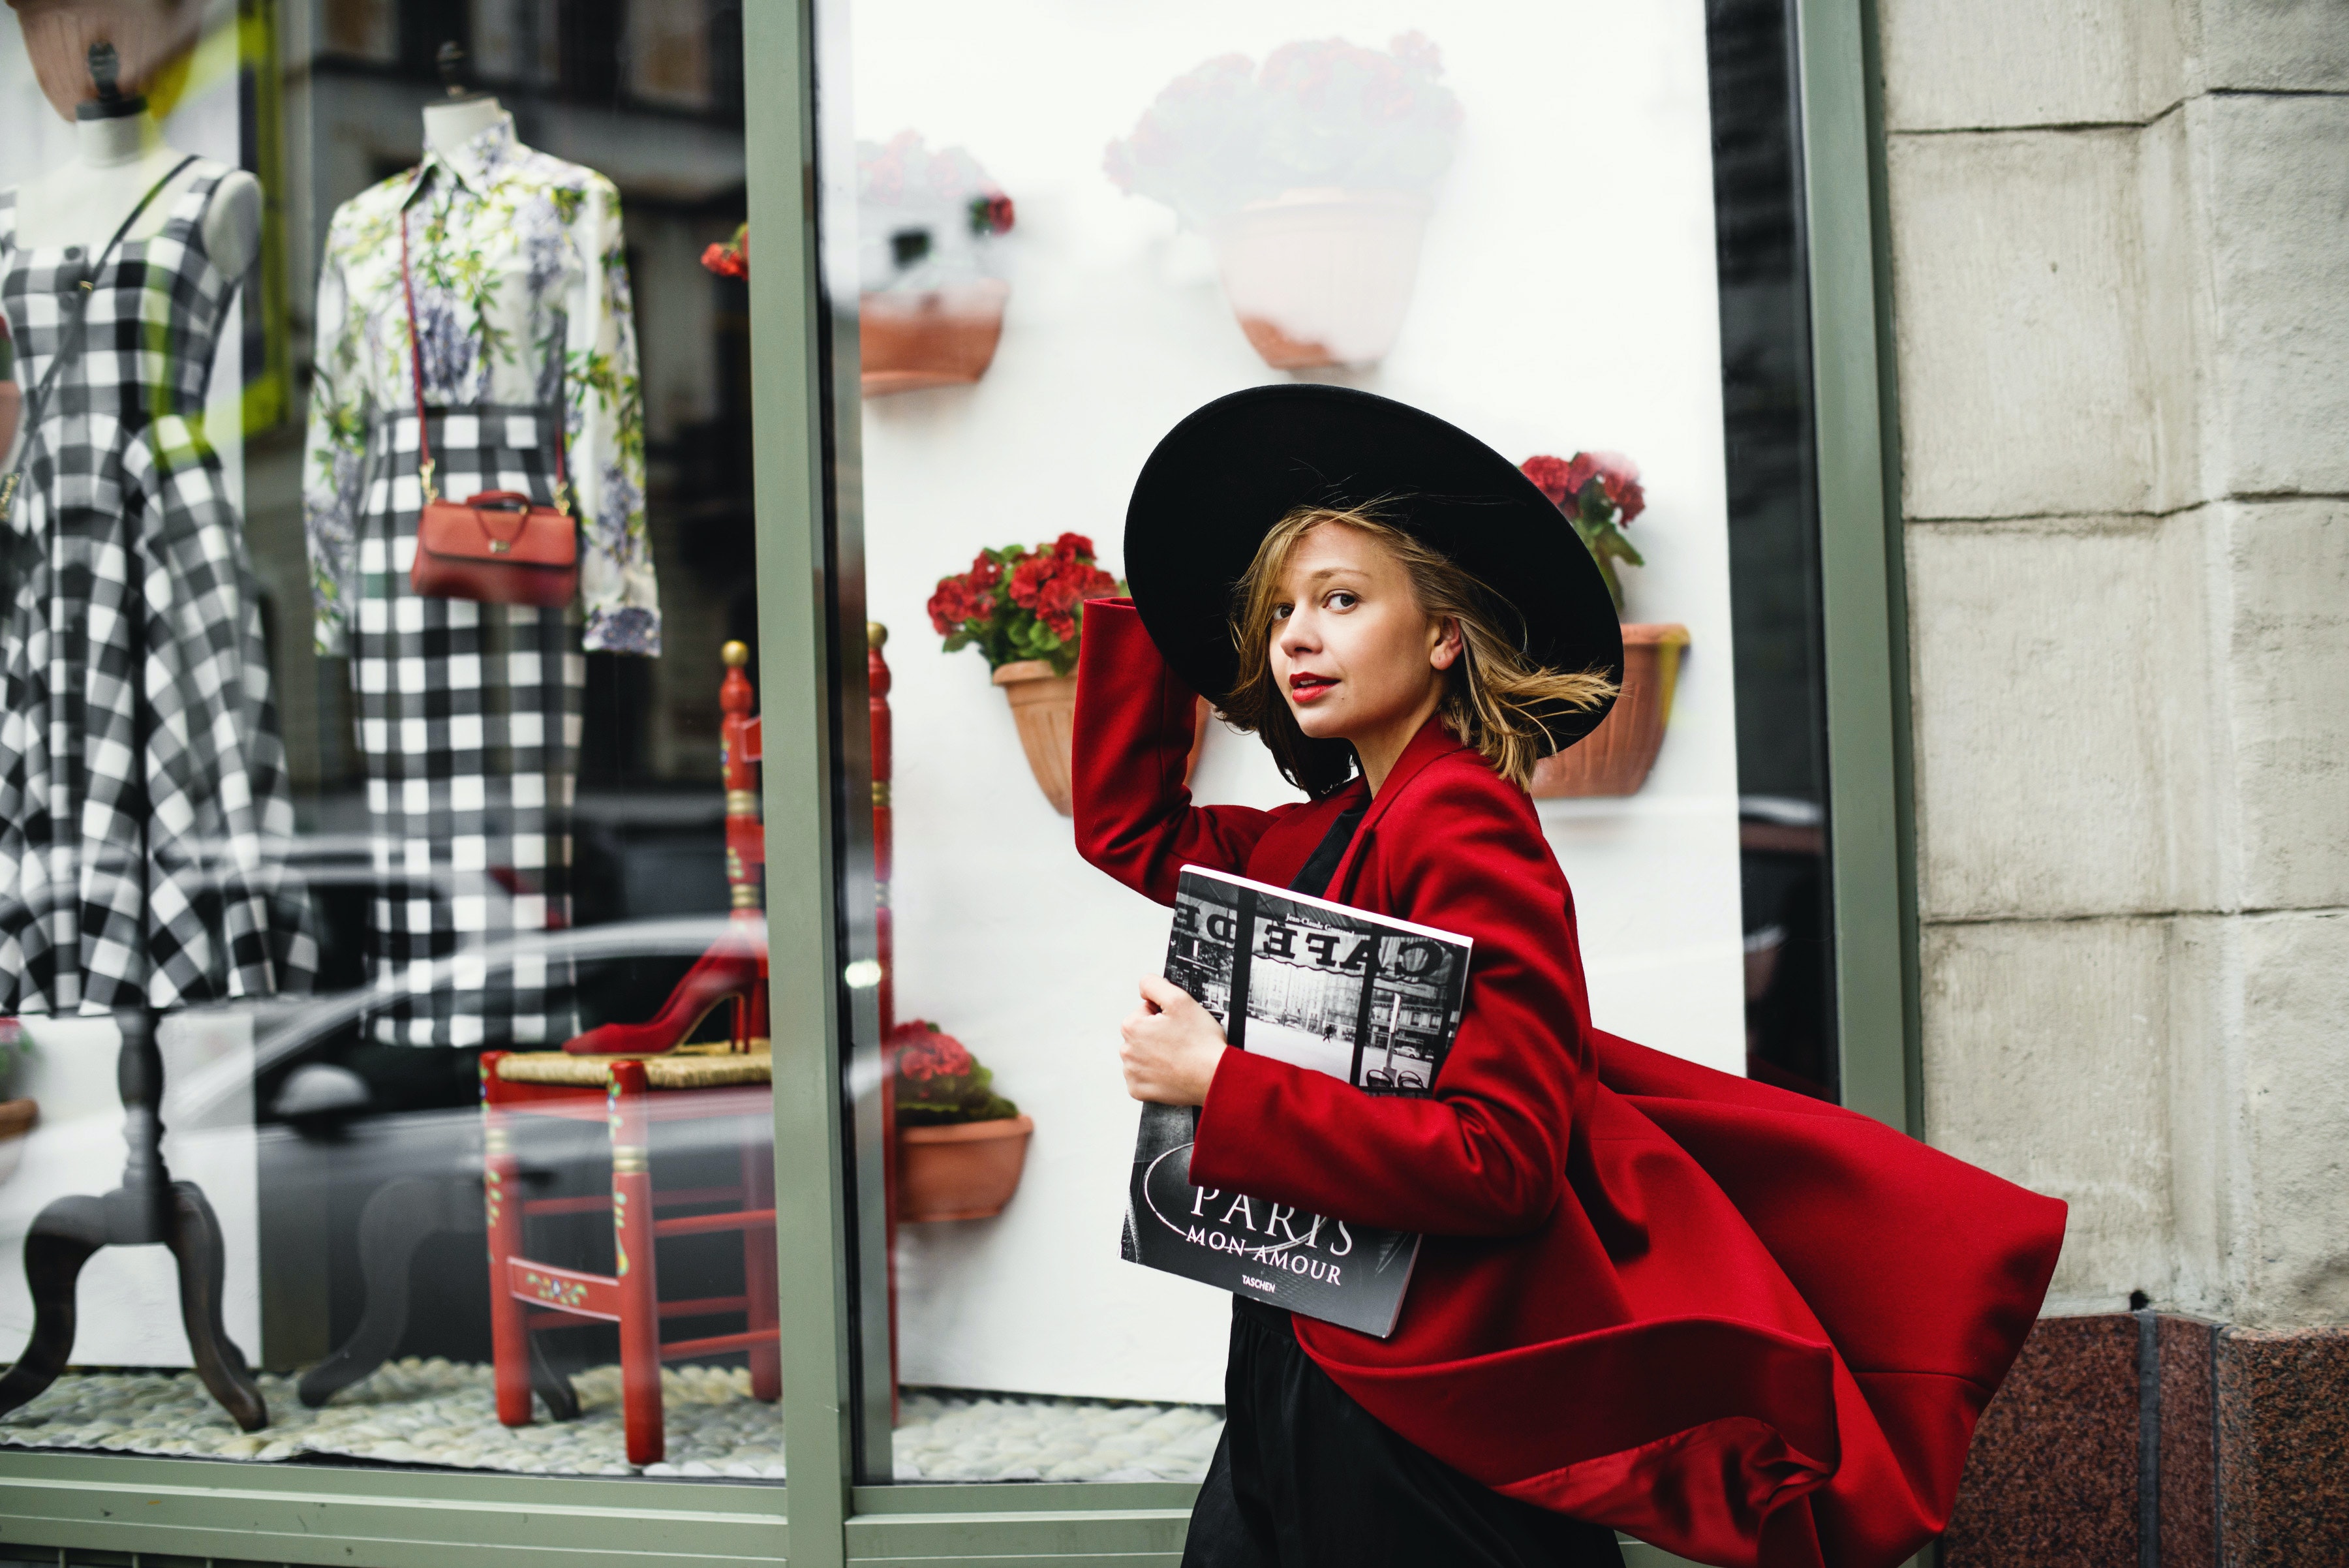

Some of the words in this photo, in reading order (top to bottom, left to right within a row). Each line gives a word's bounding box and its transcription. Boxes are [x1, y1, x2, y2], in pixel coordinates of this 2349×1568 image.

[1285, 913, 1323, 930] Jean-Claude
[1190, 1186, 1352, 1256] PARIS
[1186, 1225, 1247, 1257] MON
[1251, 1244, 1341, 1286] AMOUR
[1242, 1274, 1276, 1293] TASCHEN
